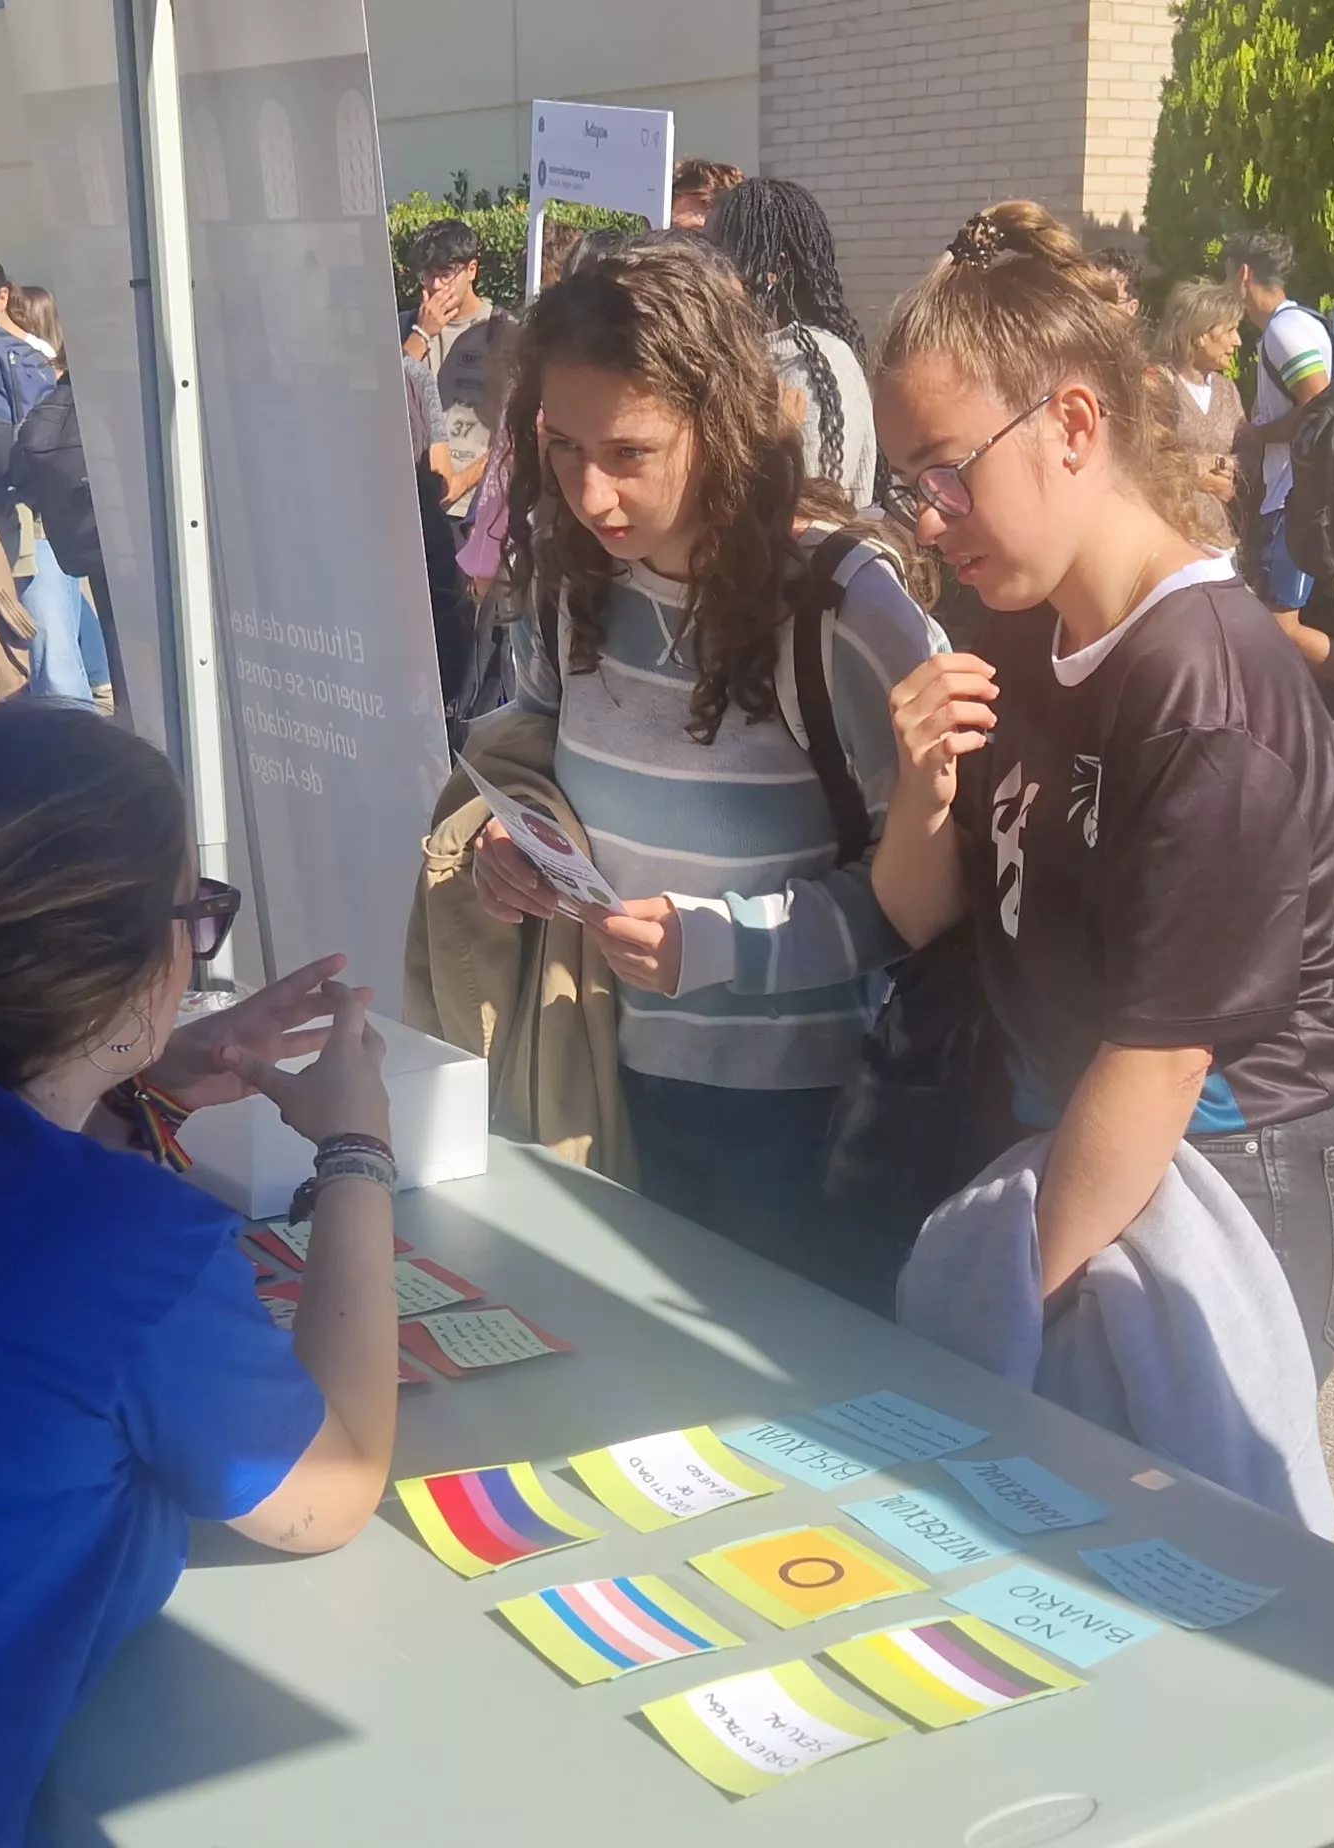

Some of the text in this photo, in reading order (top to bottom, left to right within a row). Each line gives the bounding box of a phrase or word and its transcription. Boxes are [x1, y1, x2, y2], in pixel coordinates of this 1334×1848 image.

[747, 1424, 868, 1481] BISEXUAL
[629, 1457, 697, 1512] IDENTIDAD
[675, 1485, 695, 1497] DE
[971, 1462, 1072, 1527] TRANSEXUAL
[875, 1493, 992, 1563] INTERSEXUAL
[1009, 1585, 1135, 1644] BINARIO
[1014, 1614, 1066, 1640] NO
[764, 1711, 831, 1752] SEXUAL
